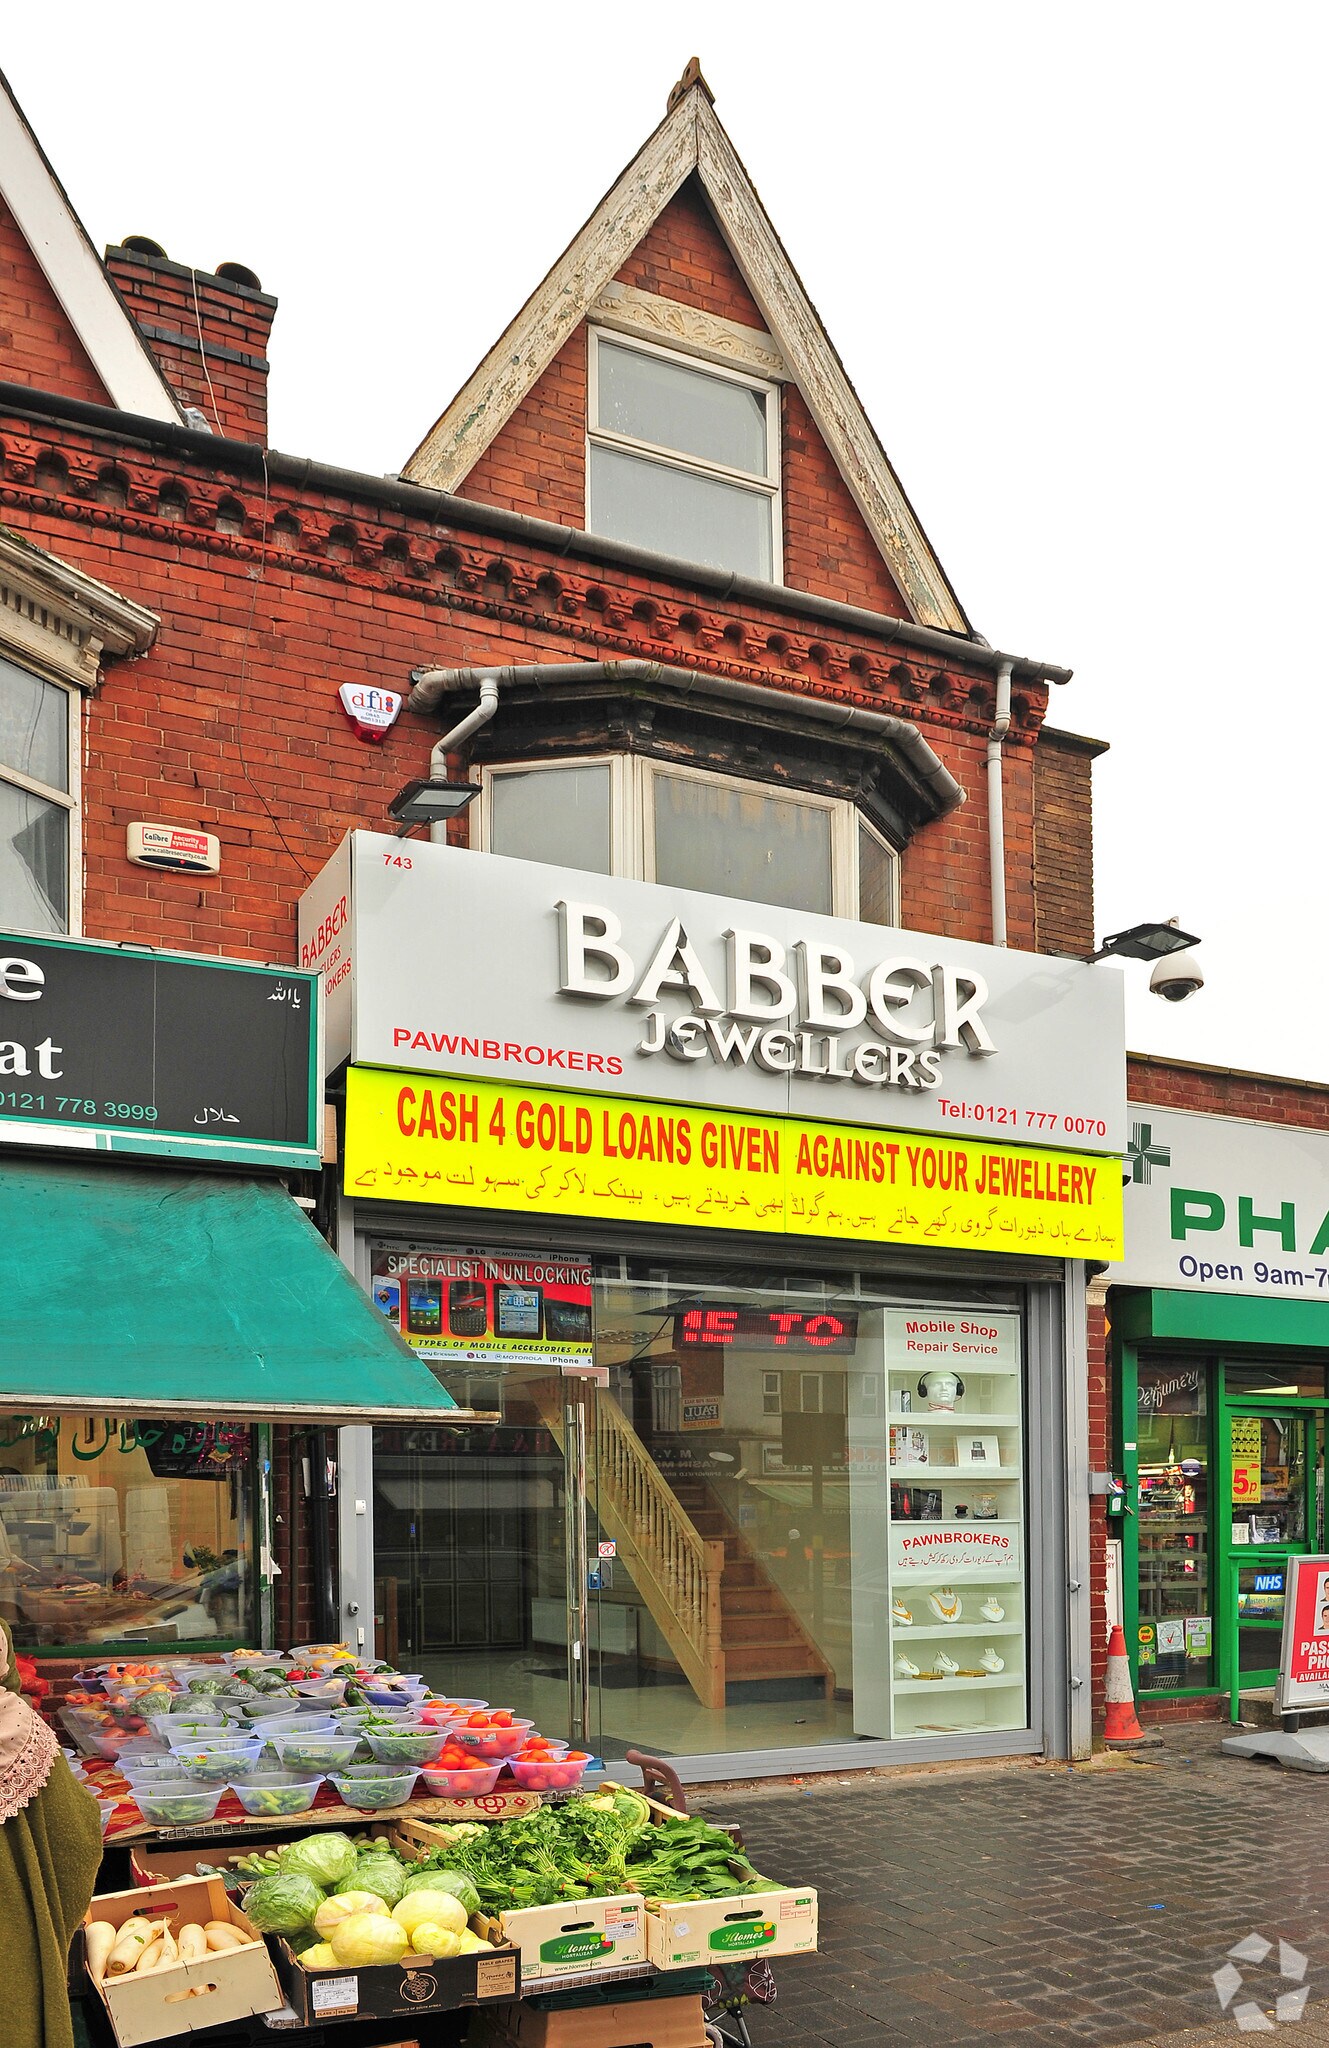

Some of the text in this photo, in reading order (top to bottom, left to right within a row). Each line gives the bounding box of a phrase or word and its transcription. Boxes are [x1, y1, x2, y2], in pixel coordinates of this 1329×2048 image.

[144, 832, 169, 843] Calibre
[172, 840, 198, 849] systems
[173, 835, 200, 845] security
[143, 847, 208, 861] www.calibresecurity.co.uk
[382, 853, 414, 870] 743
[302, 895, 349, 968] BABBER
[553, 899, 1000, 1058] BABBER
[0, 1037, 64, 1080] at
[392, 1028, 623, 1076] PAWNBROKERS
[636, 1011, 944, 1090] JEWELLERS
[55, 1097, 97, 1116] 778
[104, 1102, 158, 1121] 3999
[193, 1107, 240, 1124] حلال
[938, 1098, 1107, 1137] Tel:0121 777 0070
[398, 1086, 1097, 1206] CASH 4 GOLD LOANS GIVEN AGAINST YOUR JEWELLERY
[501, 1251, 542, 1259] MOTOROLA
[549, 1254, 580, 1263] iPhone
[387, 1255, 592, 1287] SPECIALIST IN UNLOCKING
[1179, 1255, 1329, 1288] Open 9am-7
[769, 1313, 844, 1347] TO
[906, 1320, 999, 1340] Mobile Shop
[418, 1339, 448, 1348] TYPES
[469, 1342, 507, 1350] MOBILE
[511, 1343, 572, 1354] ACCESSORIES
[906, 1340, 999, 1355] Repair Service
[1232, 1468, 1258, 1495] 5p
[902, 1532, 1010, 1551] PAWNBROKERS
[1255, 1575, 1283, 1590] NHS
[1300, 1641, 1329, 1657] PAS
[1299, 1671, 1329, 1682] AVAILA
[561, 1950, 594, 1959] HORTALIZAS
